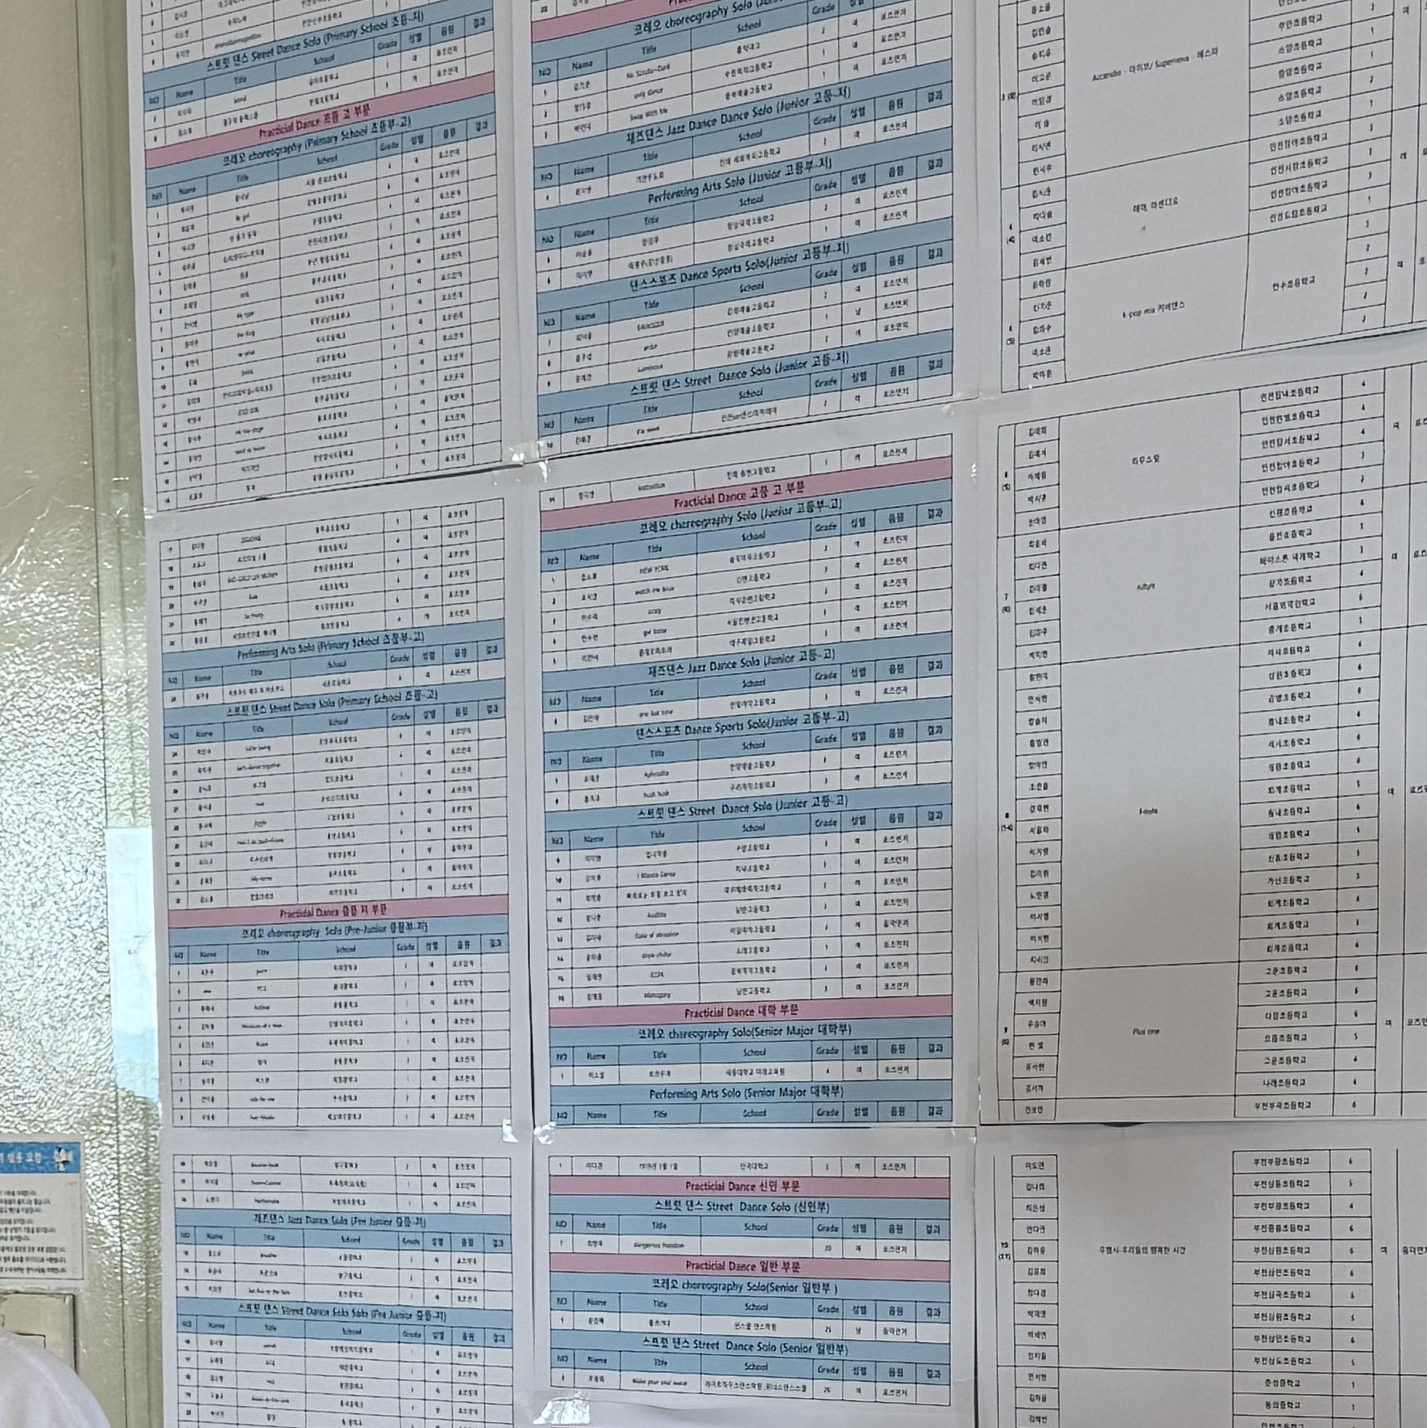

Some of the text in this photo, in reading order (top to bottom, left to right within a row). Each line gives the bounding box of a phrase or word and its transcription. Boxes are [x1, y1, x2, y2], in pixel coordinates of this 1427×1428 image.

[685, 1181, 726, 1192] Practicial
[728, 1181, 755, 1192] Dance
[781, 1181, 799, 1192] 부문
[707, 1202, 733, 1212] Street
[739, 1202, 769, 1212] Dance
[771, 1203, 791, 1212] Solo
